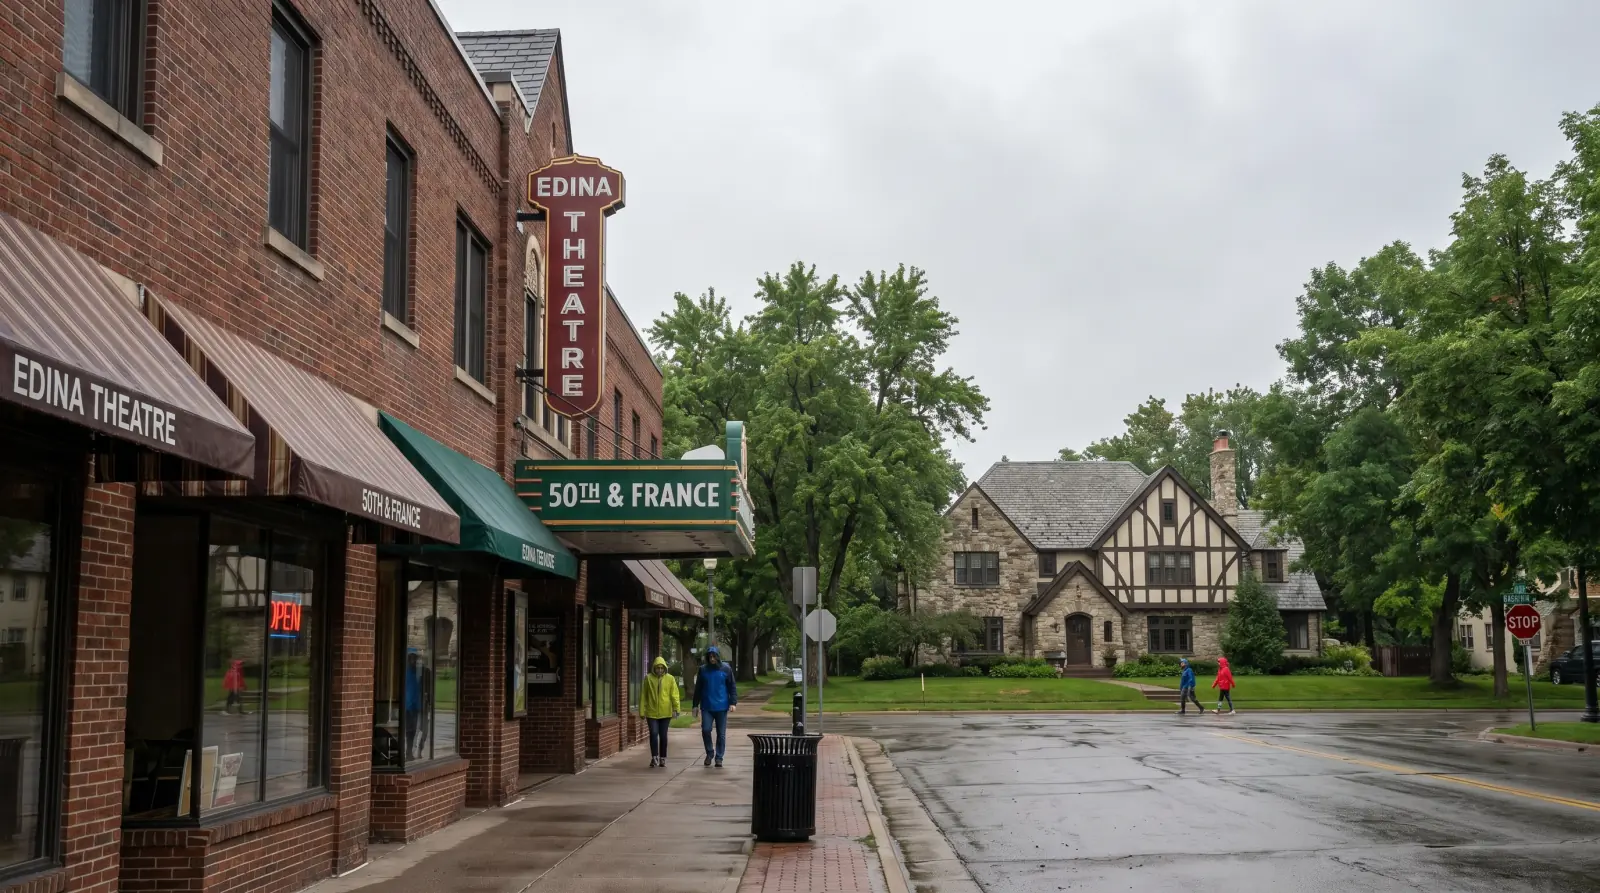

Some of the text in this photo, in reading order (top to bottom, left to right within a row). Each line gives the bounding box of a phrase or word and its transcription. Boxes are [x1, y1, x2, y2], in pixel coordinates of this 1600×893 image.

[536, 176, 613, 198] EDINA
[560, 210, 585, 397] THEATRE
[13, 353, 176, 446] EDINA THEATRE
[361, 488, 421, 529] 50TH & FRANCE
[548, 481, 720, 508] 50TH & FRANCE
[1508, 615, 1539, 629] STOP
